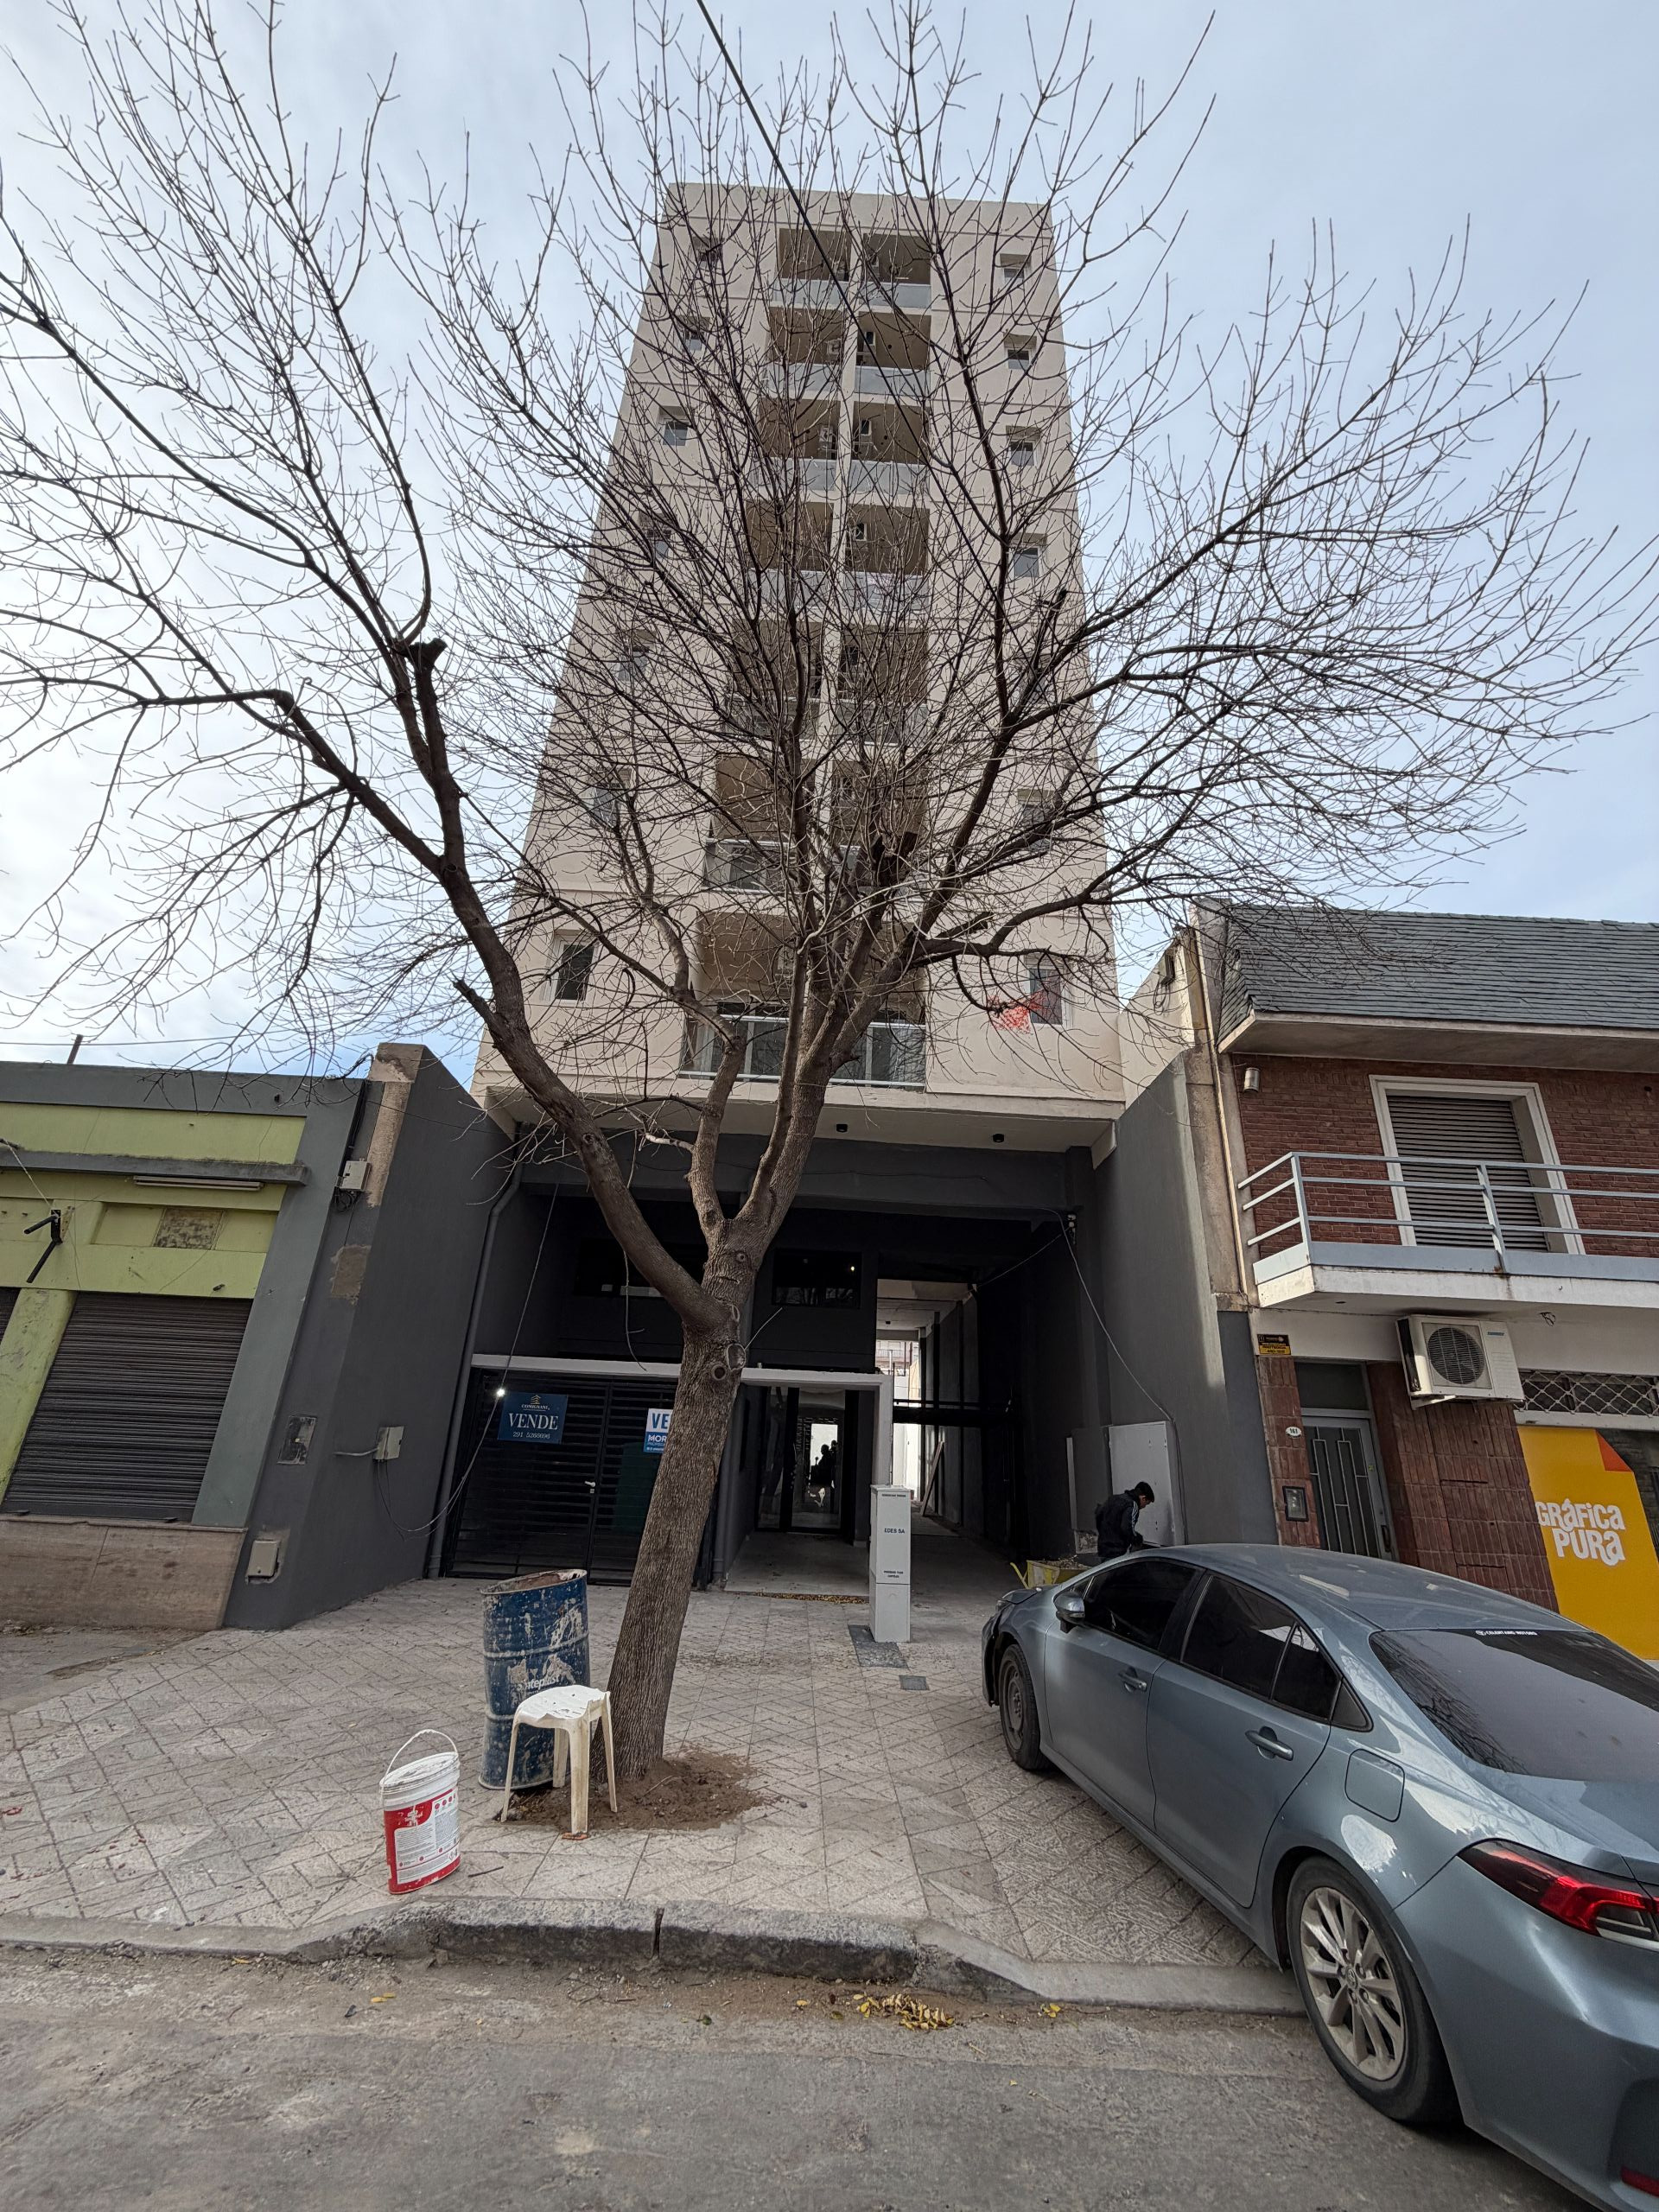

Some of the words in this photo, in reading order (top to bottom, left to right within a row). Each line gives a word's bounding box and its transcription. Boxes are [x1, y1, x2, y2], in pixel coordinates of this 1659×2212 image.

[509, 1413, 559, 1430] VENDE
[652, 1413, 671, 1430] VE
[648, 1434, 668, 1443] MOR
